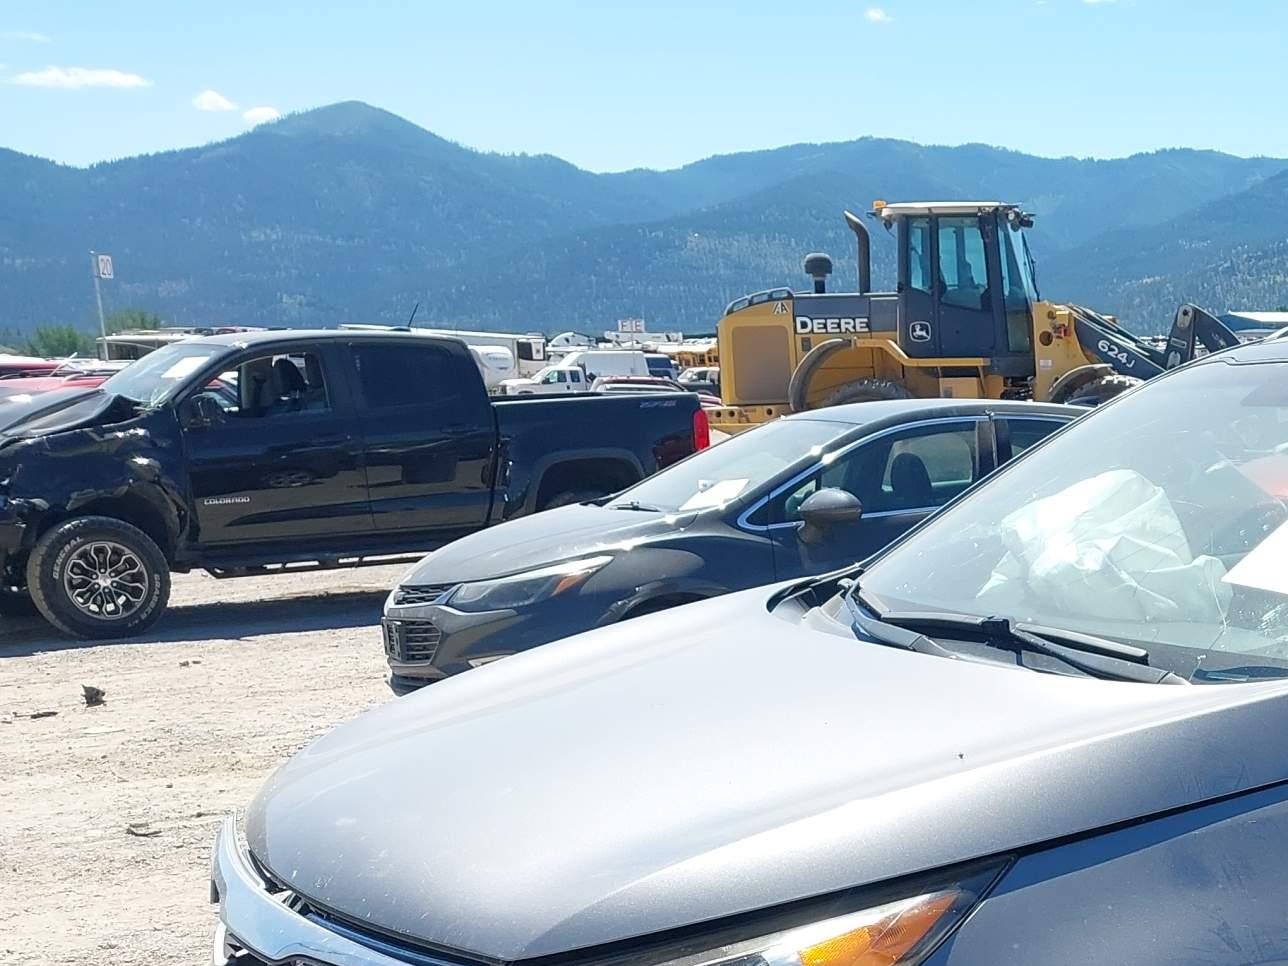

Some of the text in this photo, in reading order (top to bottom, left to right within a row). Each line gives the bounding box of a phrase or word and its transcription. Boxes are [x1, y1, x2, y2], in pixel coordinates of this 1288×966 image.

[795, 316, 869, 333] DEERE
[1098, 339, 1135, 368] 624J
[204, 496, 250, 505] COLORADO
